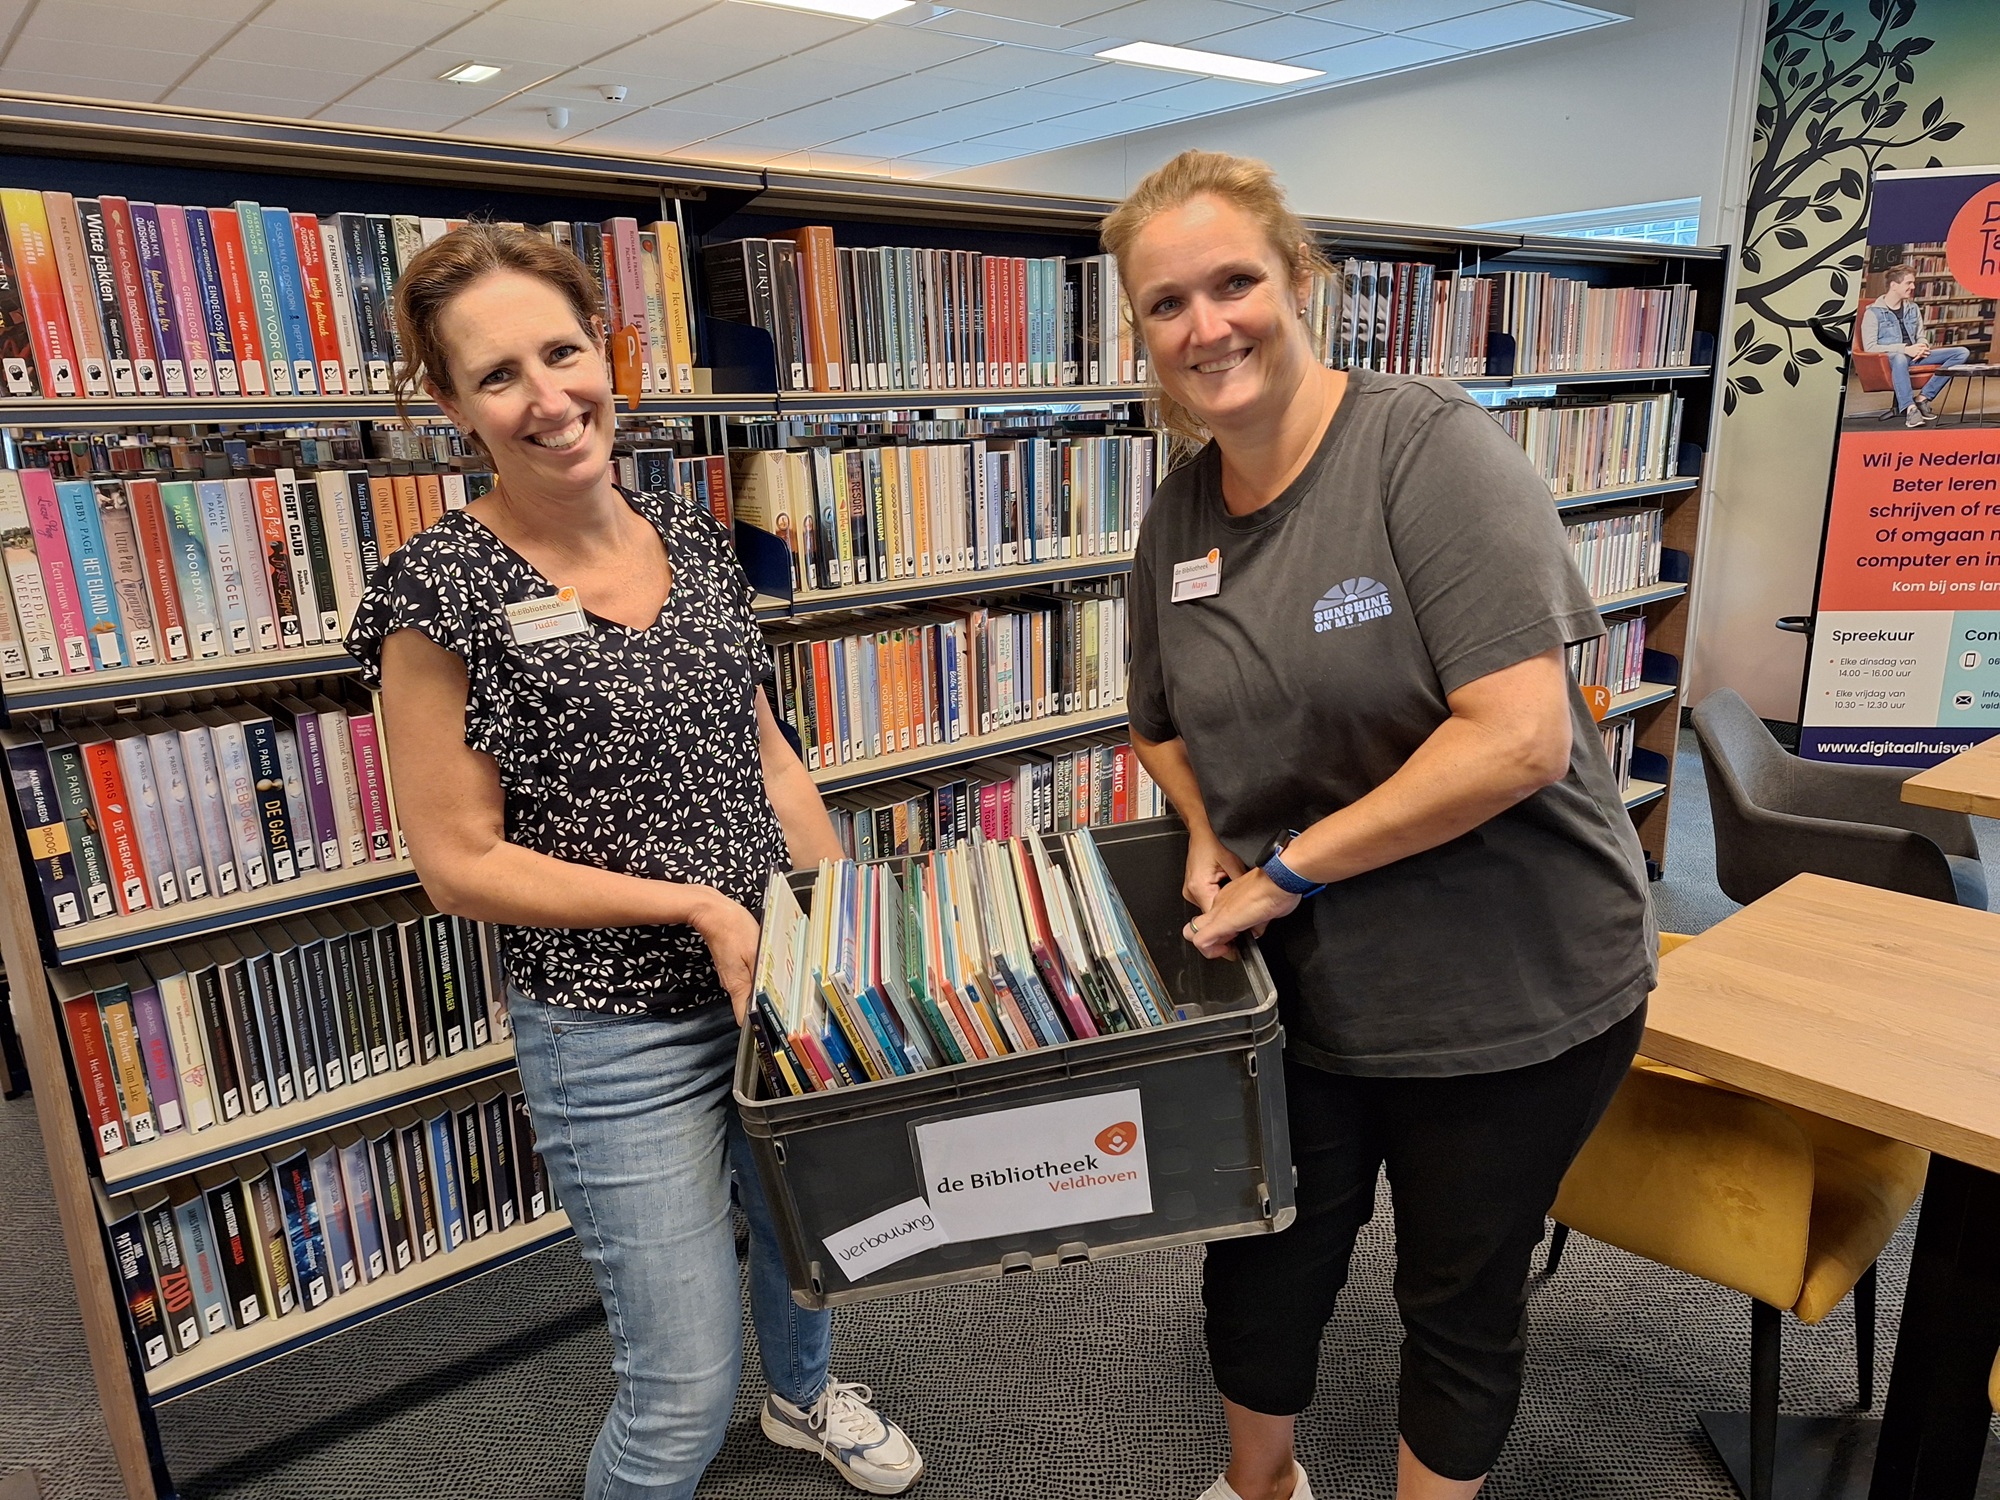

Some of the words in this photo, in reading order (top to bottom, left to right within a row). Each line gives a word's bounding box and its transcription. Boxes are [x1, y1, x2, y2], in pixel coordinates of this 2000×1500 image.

[86, 213, 104, 252] Witte
[135, 217, 150, 260] OUDSHOORN
[245, 208, 258, 255] OUDSHOORN
[300, 227, 312, 266] OUDSHOORN
[376, 223, 387, 255] MARISKA
[329, 244, 340, 273] EENZAME
[381, 256, 393, 291] OVERMAN
[90, 255, 114, 302] pakken
[334, 273, 344, 298] HOOGTE
[182, 285, 199, 339] GRENZELOOS
[208, 285, 224, 331] EINDELOOS
[258, 270, 274, 313] RECEPT
[266, 312, 280, 352] VOOR
[672, 292, 680, 307] Het
[673, 308, 683, 344] weeshuis
[627, 335, 636, 367] P
[1863, 453, 1892, 467] Wil
[1895, 452, 1913, 471] je
[711, 469, 722, 490] SARA
[1893, 478, 1943, 492] Beter
[1948, 477, 1996, 491] leren
[215, 493, 229, 533] NATHALIE
[282, 483, 299, 520] FIGHT
[334, 491, 346, 530] Michael
[356, 483, 368, 513] Marina
[376, 487, 391, 516] CONNIE
[404, 485, 418, 514] CONNIE
[427, 484, 440, 512] CONNIE
[851, 481, 864, 516] RESORT
[1870, 502, 1955, 521] schrijven
[1961, 501, 1980, 516] of
[72, 493, 88, 524] LIBBY
[80, 528, 94, 555] PAGE
[173, 504, 184, 529] PAGIE
[181, 496, 196, 536] NATHALIE
[207, 503, 218, 527] PAGIE
[359, 512, 371, 538] Palmer
[874, 486, 885, 542] SANATORIUM
[290, 525, 305, 557] CLUB
[381, 519, 396, 549] PALMEN
[1876, 528, 1897, 542] Of
[1902, 530, 1984, 546] omgaan
[51, 561, 64, 579] Een
[83, 557, 102, 578] HET
[218, 544, 239, 610] IJSENGEL
[1182, 563, 1208, 574] Bibliotheek
[1857, 554, 1951, 571] computer
[1956, 556, 1979, 566] en
[185, 544, 208, 615] NOORDKAAP
[1192, 582, 1207, 590] Maya
[1892, 581, 1925, 592] Kom
[1929, 580, 1947, 594] bij
[1950, 582, 1975, 591] ons
[15, 573, 39, 644] WEESHUIS
[27, 573, 46, 621] LIEFDE
[55, 580, 69, 610] nieuw
[86, 578, 109, 615] EILAND
[1314, 593, 1391, 623] SUNSHINE
[1315, 621, 1332, 633] ON
[1335, 614, 1354, 627] MY
[1358, 605, 1392, 622] MIND
[1832, 630, 1914, 644] Spreekuur
[1860, 657, 1897, 667] dinsdag
[1872, 669, 1893, 677] 16.00
[1594, 690, 1606, 707] R
[1834, 701, 1855, 709] 10.30
[1867, 701, 1888, 709] 12.30
[1836, 690, 1852, 698] Elke
[1855, 690, 1886, 699] vrijdag
[254, 728, 265, 748] B.A.
[335, 719, 346, 755] Anatomie
[96, 749, 107, 770] B.A.
[202, 752, 211, 771] PARIS
[258, 749, 273, 776] PARIS
[61, 753, 73, 774] B.A.
[67, 775, 83, 805] PARIS
[101, 771, 117, 799] PARIS
[234, 777, 257, 843] GEBROKEN
[264, 800, 282, 818] DE
[1044, 784, 1052, 829] WINTER
[81, 835, 91, 847] DE
[112, 819, 124, 834] DE
[268, 818, 289, 850] GAST
[42, 827, 57, 855] DROOG
[50, 856, 63, 881] WATER
[436, 922, 447, 941] JAMES
[363, 957, 373, 985] Patterson
[438, 941, 451, 973] PATTERSON
[234, 971, 243, 990] James
[262, 965, 271, 984] James
[317, 970, 326, 1000] Patterson
[342, 963, 351, 991] Patterson
[205, 978, 213, 996] James
[210, 998, 220, 1028] Patterson
[238, 991, 249, 1021] Patterson
[266, 985, 276, 1016] Patterson
[293, 979, 302, 1009] Patterson
[1032, 984, 1044, 1002] Boris
[1041, 1000, 1049, 1012] en
[1046, 1010, 1055, 1021] Bo
[78, 1012, 87, 1025] Ann
[113, 1013, 124, 1029] Ann
[82, 1026, 95, 1056] Patchett
[118, 1029, 131, 1063] Patchett
[89, 1058, 100, 1072] Het
[125, 1064, 136, 1083] Tom
[92, 1072, 106, 1106] Hollandse
[128, 1084, 142, 1103] Lake
[937, 1177, 964, 1194] de
[970, 1154, 1099, 1190] Bibliotheek
[1049, 1170, 1137, 1192] Veldhoven
[159, 1211, 170, 1232] JAMES
[225, 1209, 239, 1237] PATTERSON
[163, 1232, 181, 1269] PATTERSON
[838, 1213, 936, 1262] verbouwing
[115, 1232, 139, 1280] PATTERSON
[160, 1264, 193, 1313] ZOO
